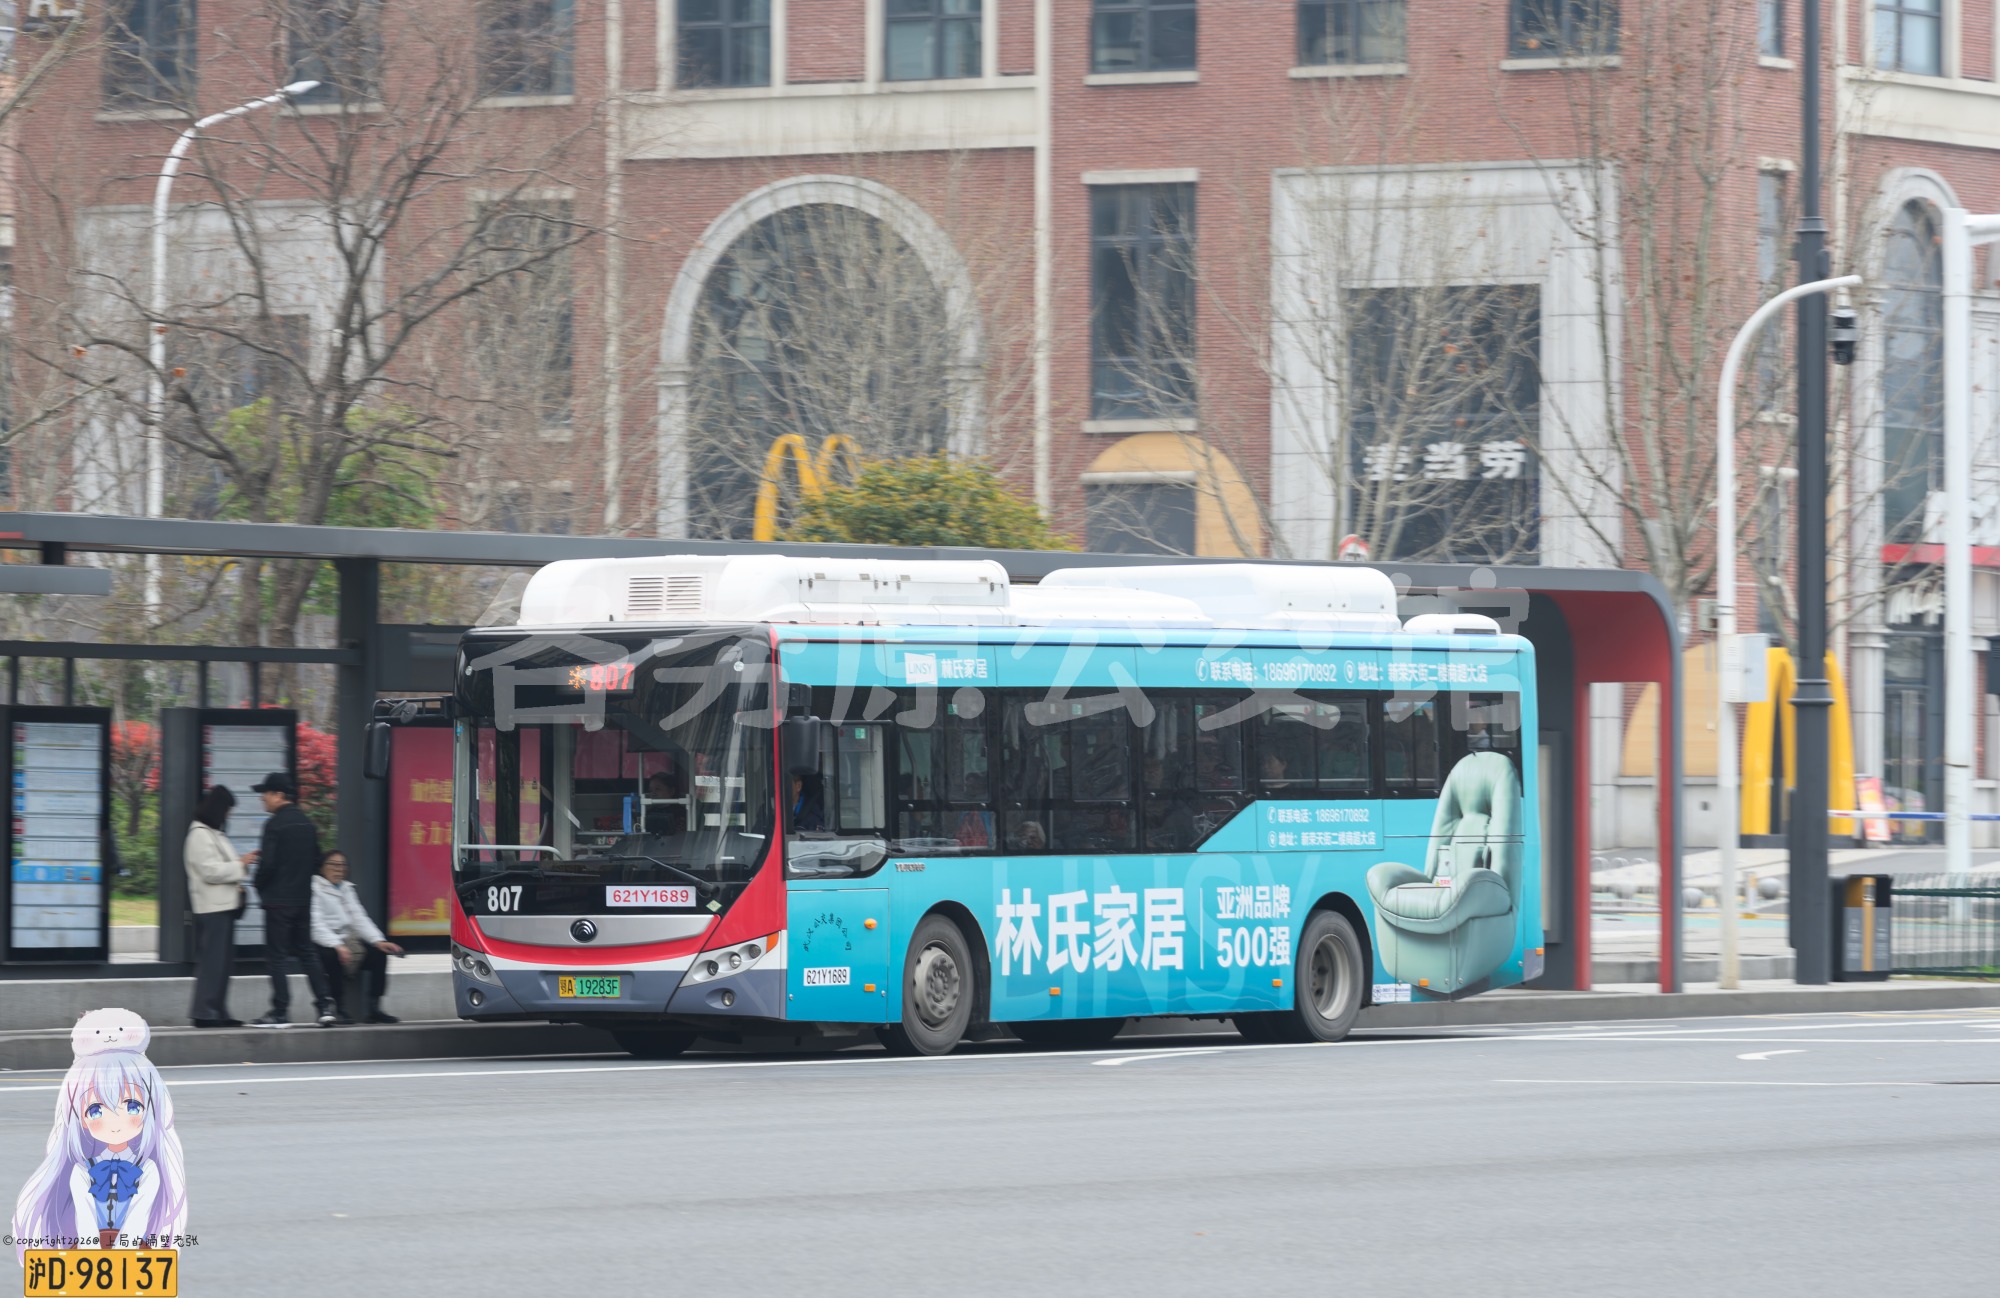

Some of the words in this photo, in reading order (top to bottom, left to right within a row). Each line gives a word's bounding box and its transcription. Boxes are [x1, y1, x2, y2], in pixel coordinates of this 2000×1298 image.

[589, 663, 635, 691] 807
[908, 663, 932, 675] LINSY
[940, 659, 988, 679] 林氏家居
[1262, 662, 1337, 683] 18696170892
[487, 886, 523, 911] 807
[613, 889, 689, 904] 621Y1689
[1216, 884, 1291, 919] 亚洲品牌
[995, 885, 1187, 976] 林氏家居
[1216, 926, 1291, 968] 500强
[806, 968, 848, 985] 621Y1689
